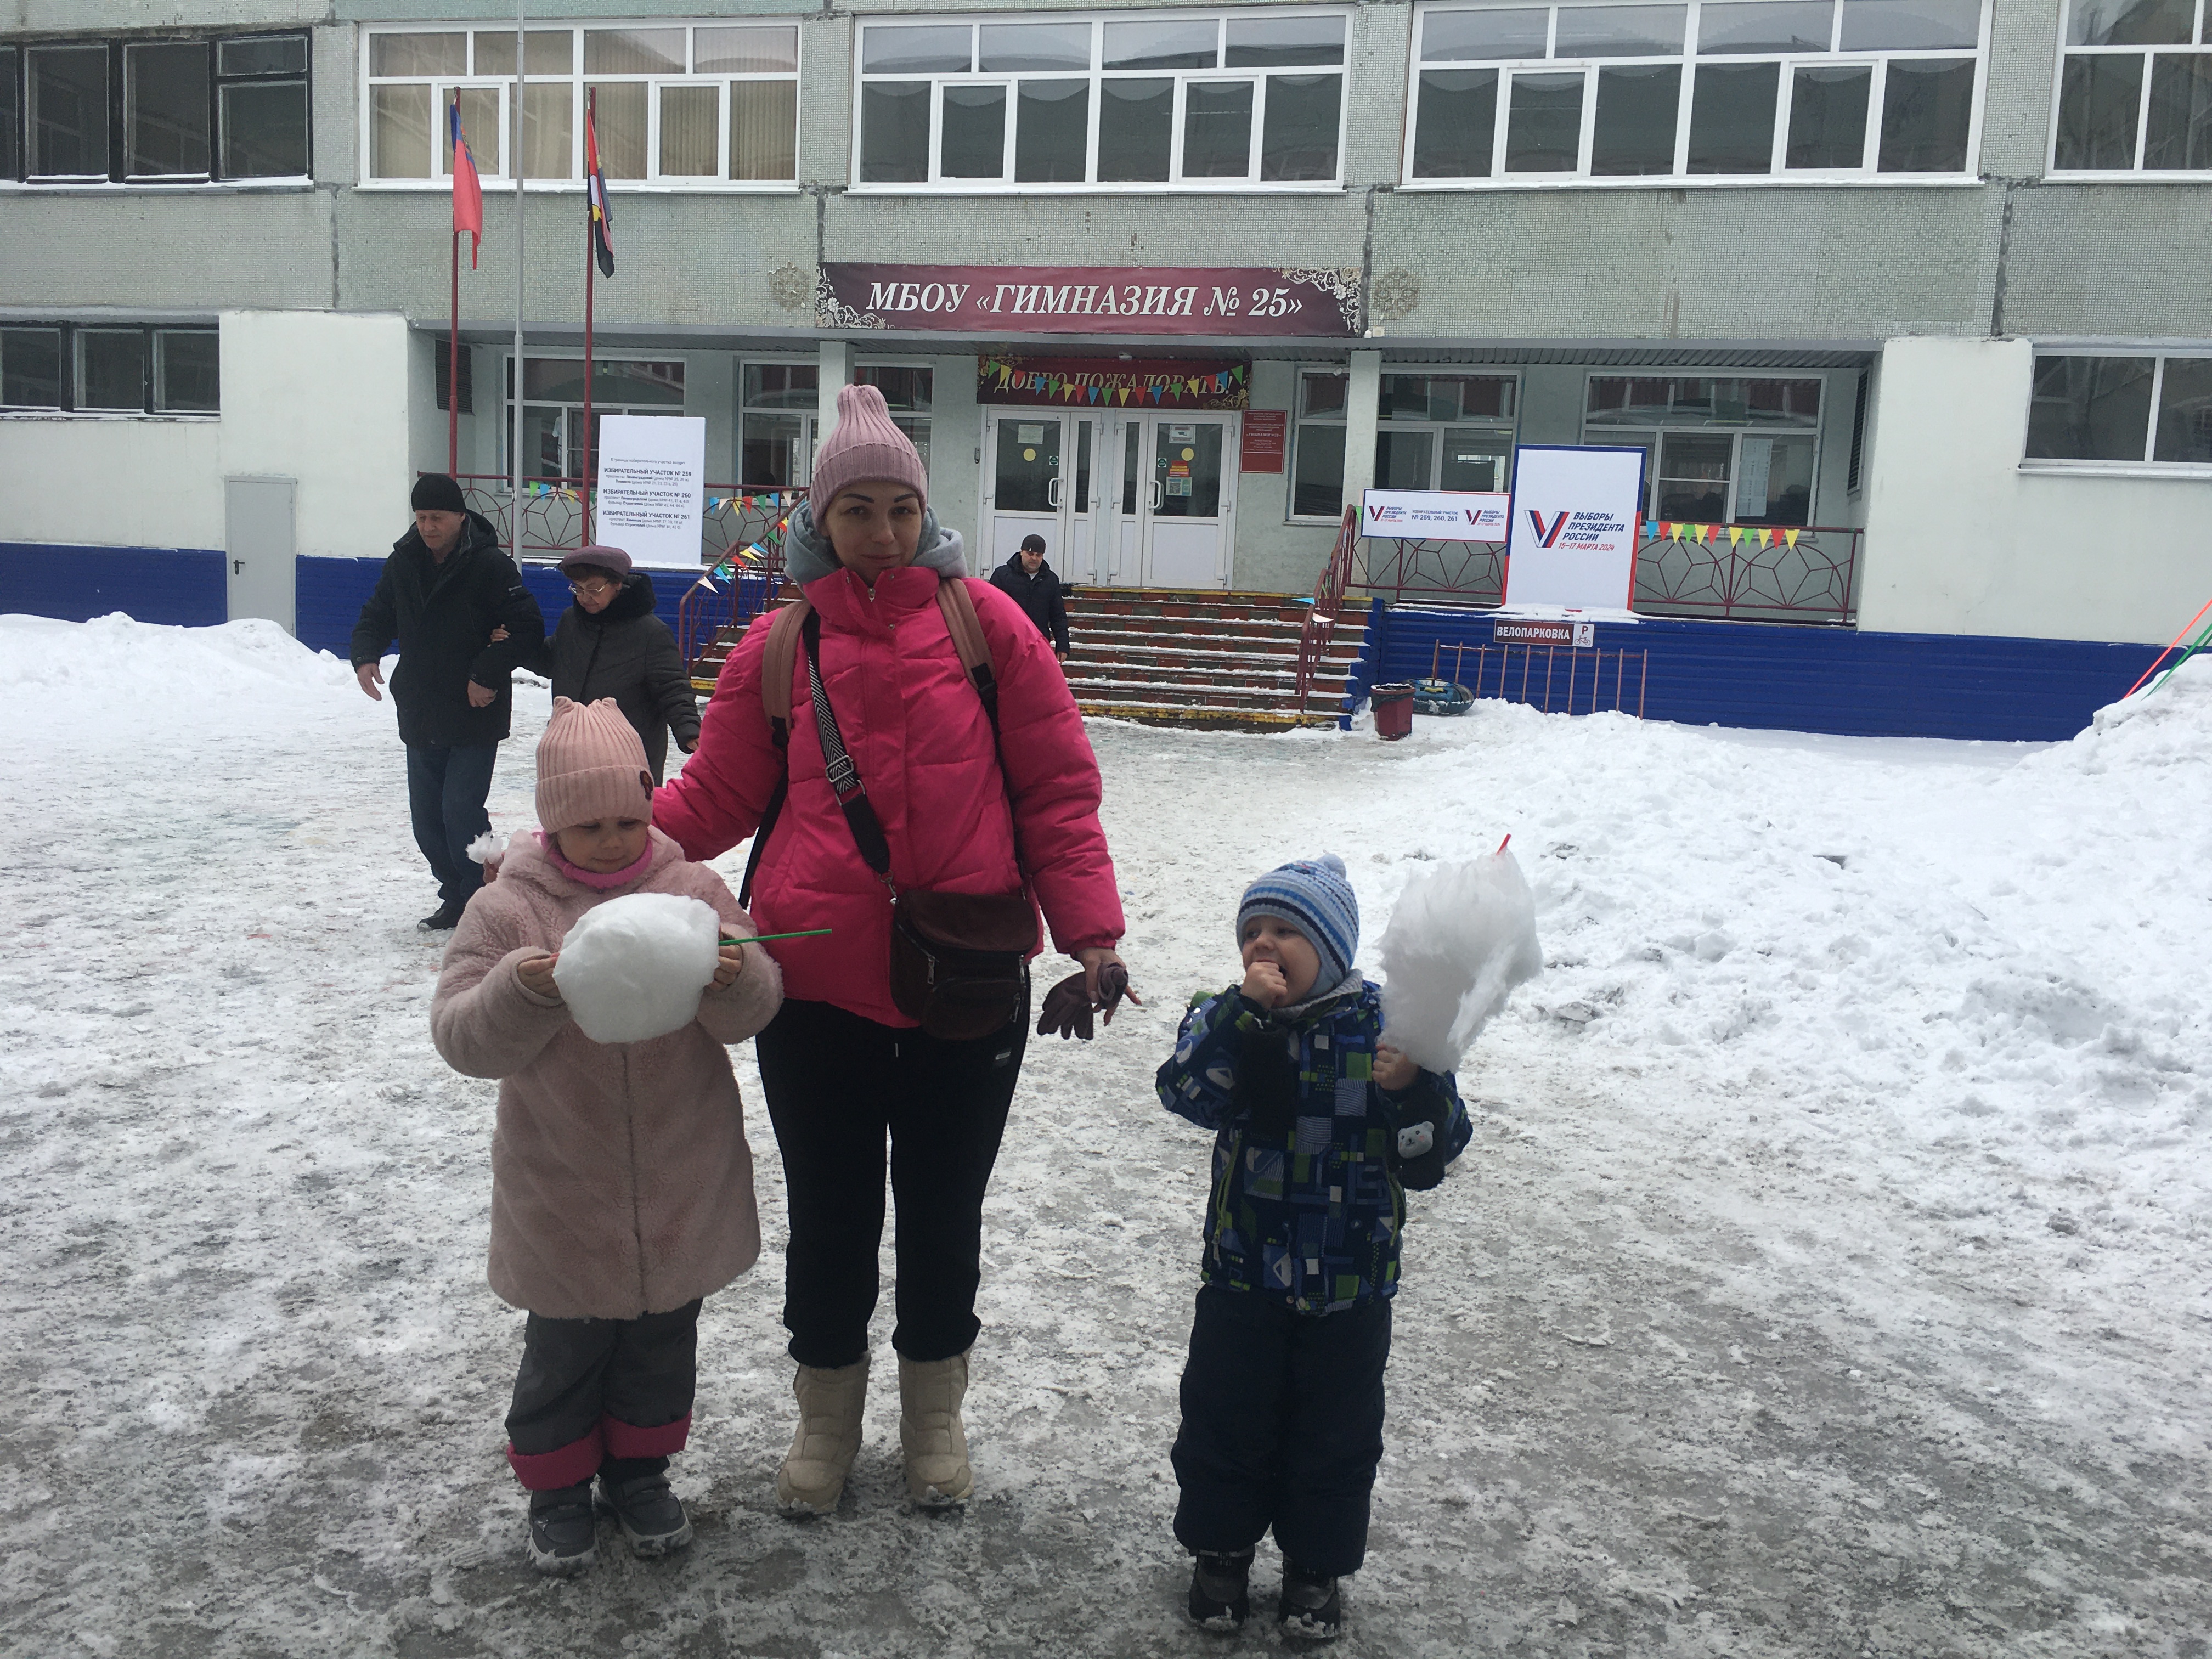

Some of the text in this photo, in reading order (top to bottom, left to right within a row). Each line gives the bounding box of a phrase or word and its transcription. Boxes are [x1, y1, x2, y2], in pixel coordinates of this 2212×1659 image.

[866, 282, 1303, 317] МБОУ «ГИМНАЗИЯ № 25»
[1573, 512, 1615, 521] ВЫБОРЫ
[1568, 522, 1624, 532] ПРЕЗИДЕНТА
[1562, 532, 1600, 541] РОССИИ
[1497, 626, 1570, 640] ВЕЛОПАРКОВКА
